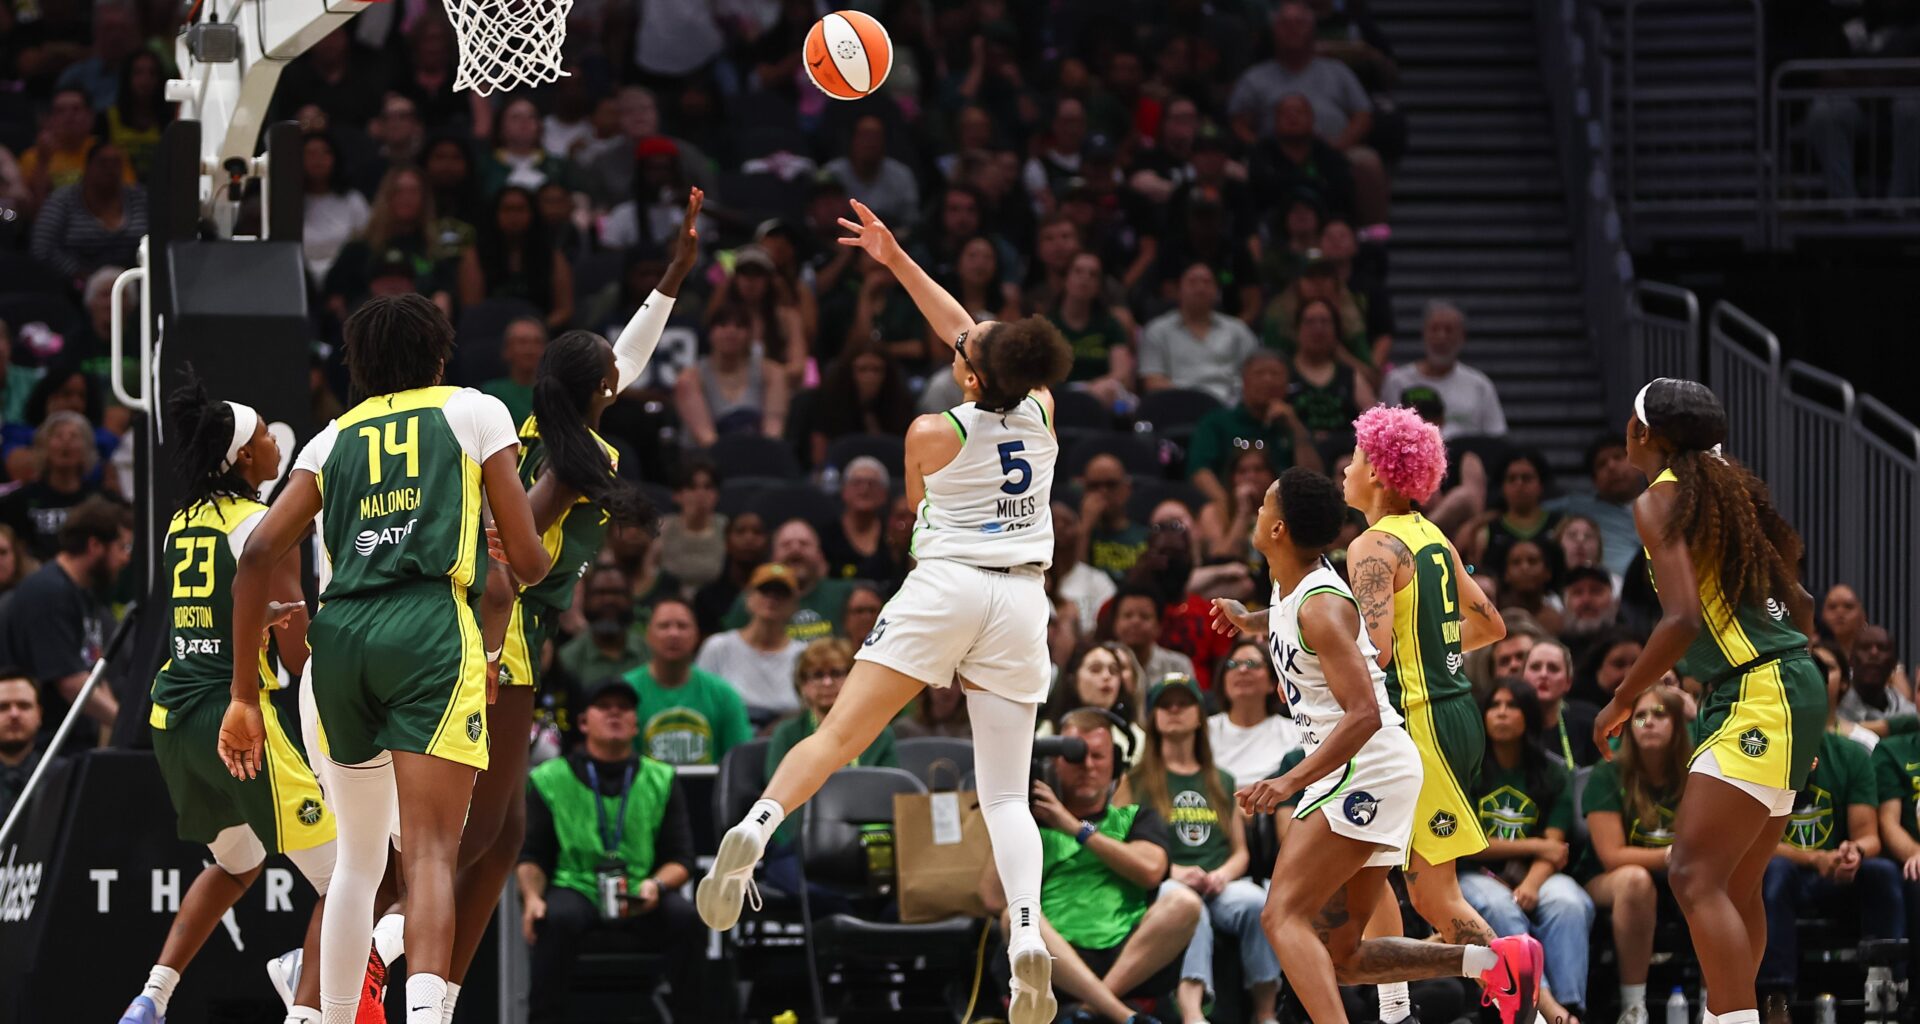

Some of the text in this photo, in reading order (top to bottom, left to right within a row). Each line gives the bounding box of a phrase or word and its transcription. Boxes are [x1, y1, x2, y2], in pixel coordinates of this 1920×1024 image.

[359, 415, 419, 485] 14
[997, 440, 1032, 495] 5
[360, 487, 421, 520] MALONGA
[997, 496, 1035, 518] MILES
[172, 536, 217, 598] 23
[1431, 553, 1454, 614] 2
